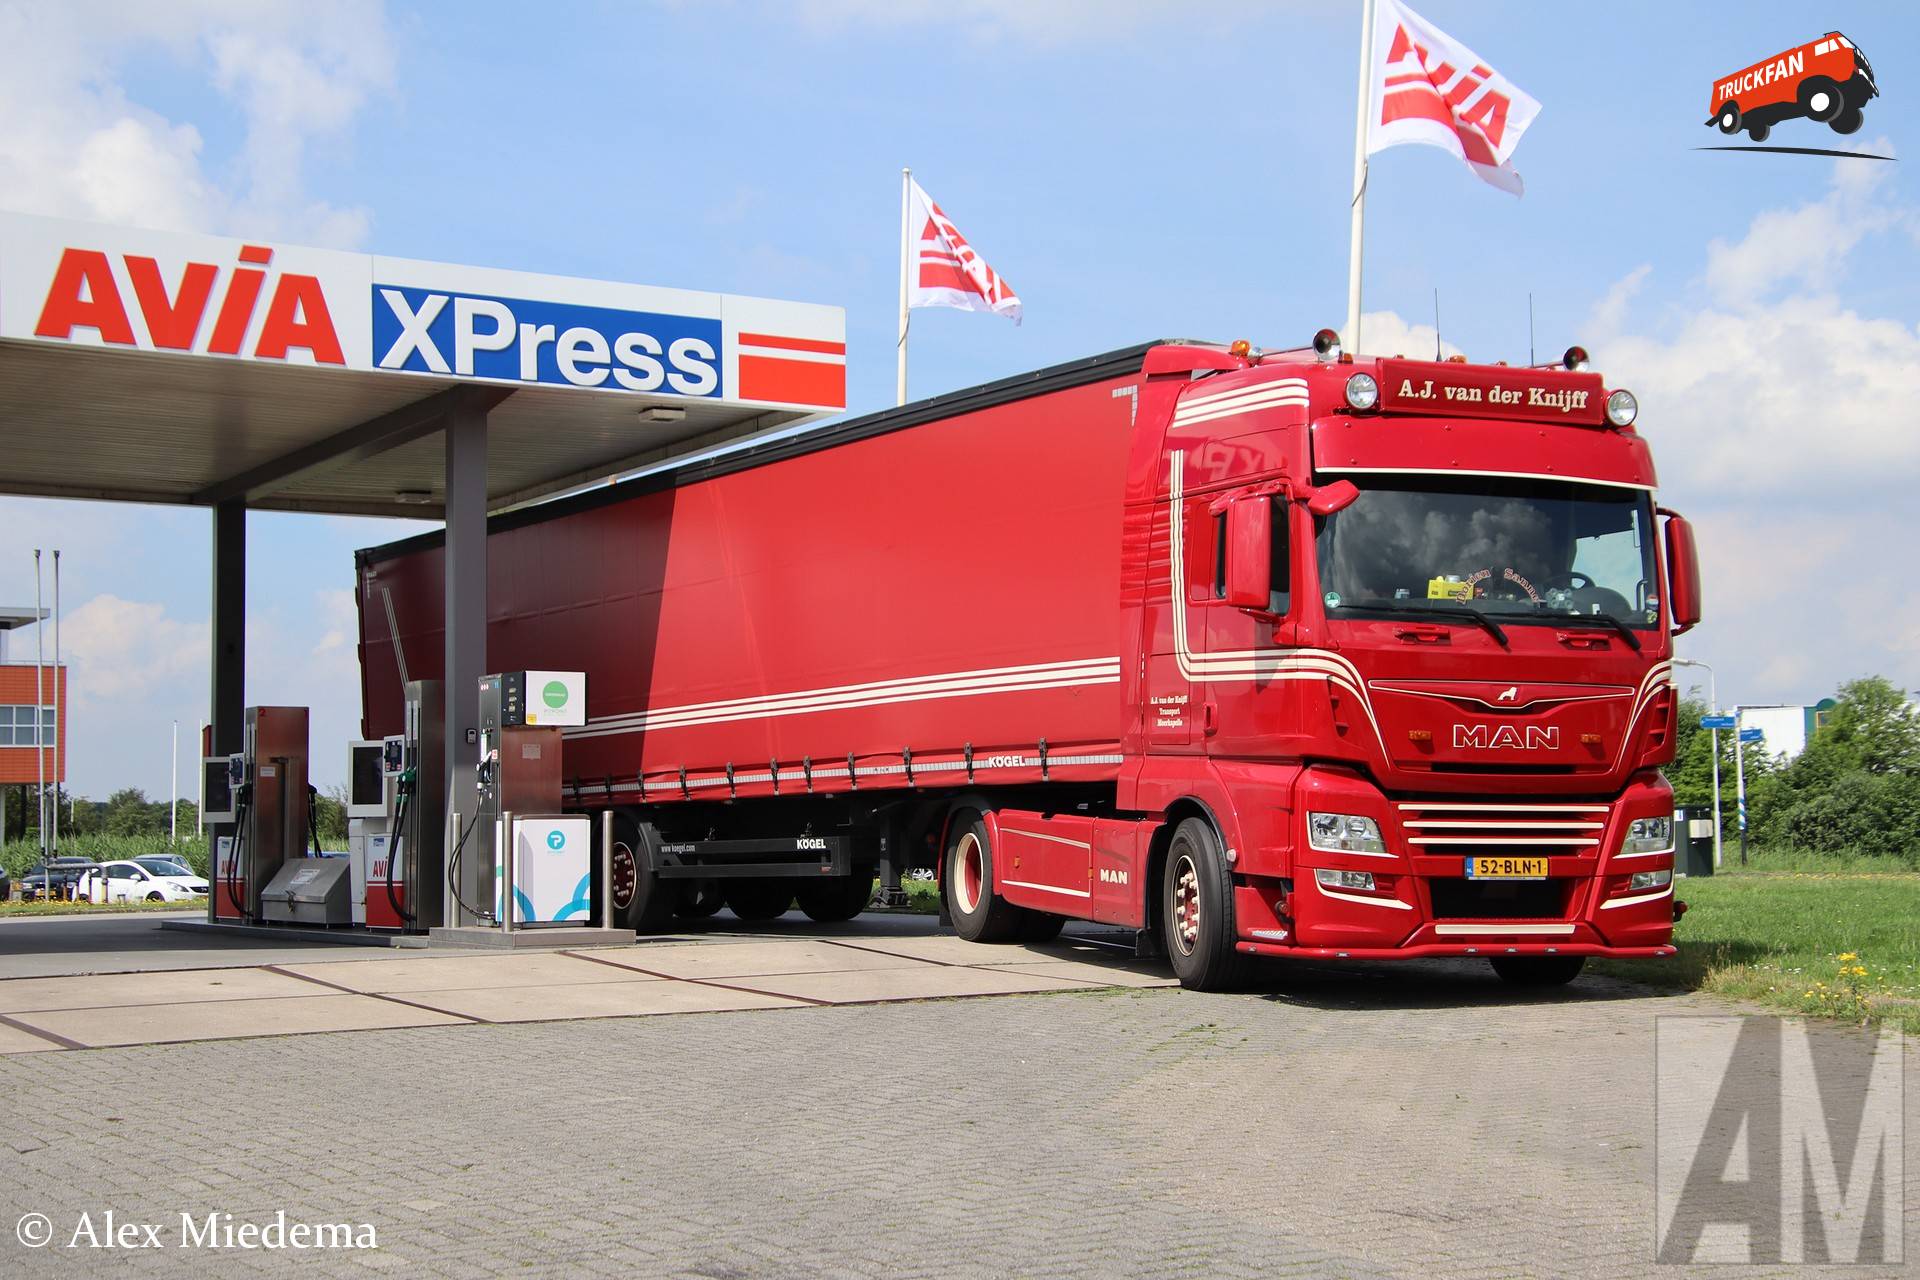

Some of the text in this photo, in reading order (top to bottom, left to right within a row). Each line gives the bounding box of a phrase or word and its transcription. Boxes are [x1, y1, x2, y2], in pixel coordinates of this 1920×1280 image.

[379, 288, 719, 396] XPress
[1398, 379, 1590, 412] A.J. van der Knijff
[1452, 724, 1560, 750] MAN
[989, 755, 1026, 768] KÖGEL
[796, 838, 827, 850] KÖGEL
[1480, 860, 1542, 874] 52-BLN-1
[1100, 868, 1128, 885] MAN
